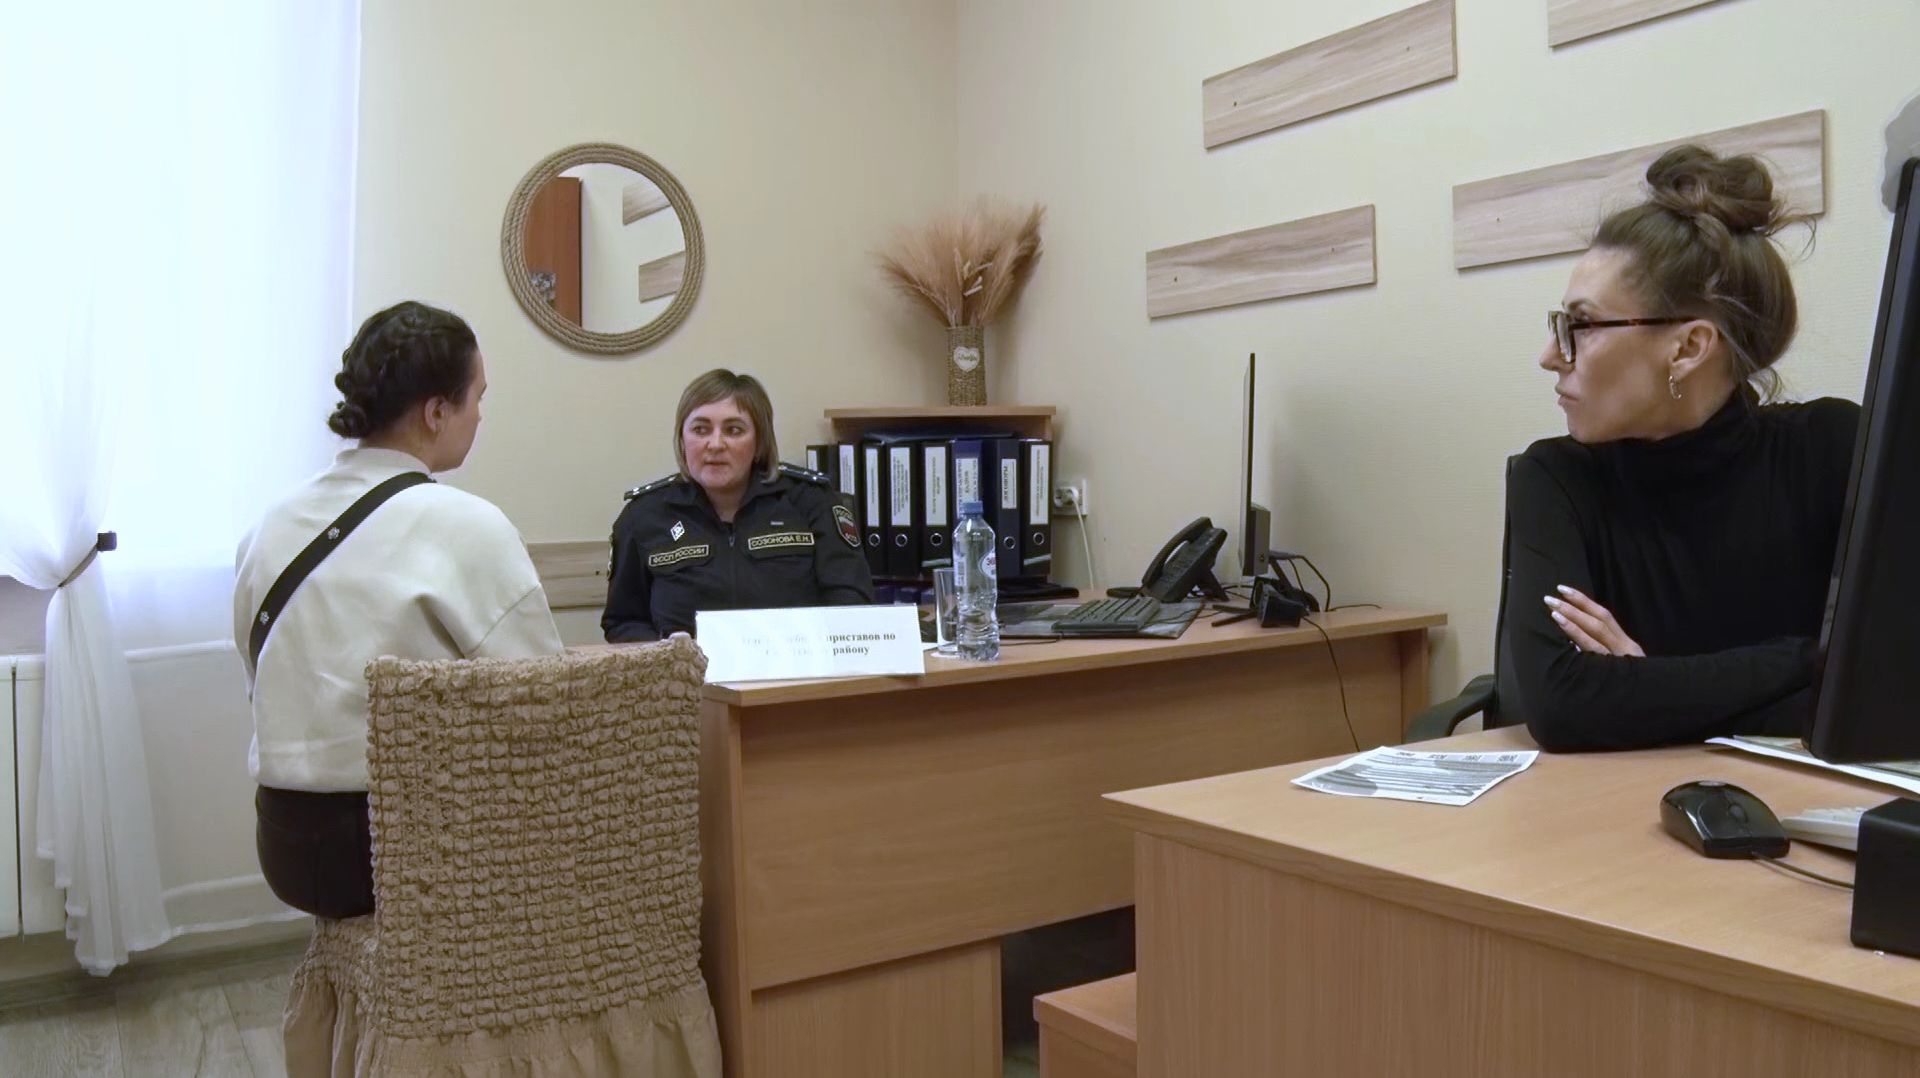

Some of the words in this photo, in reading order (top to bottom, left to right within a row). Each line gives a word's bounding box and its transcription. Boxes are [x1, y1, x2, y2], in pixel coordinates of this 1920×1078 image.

[752, 535, 794, 546] СОЗОНОВА
[653, 555, 674, 564] ФССП
[675, 548, 705, 558] РОССИИ
[826, 633, 880, 644] приставов
[883, 632, 896, 640] по
[832, 644, 871, 656] району
